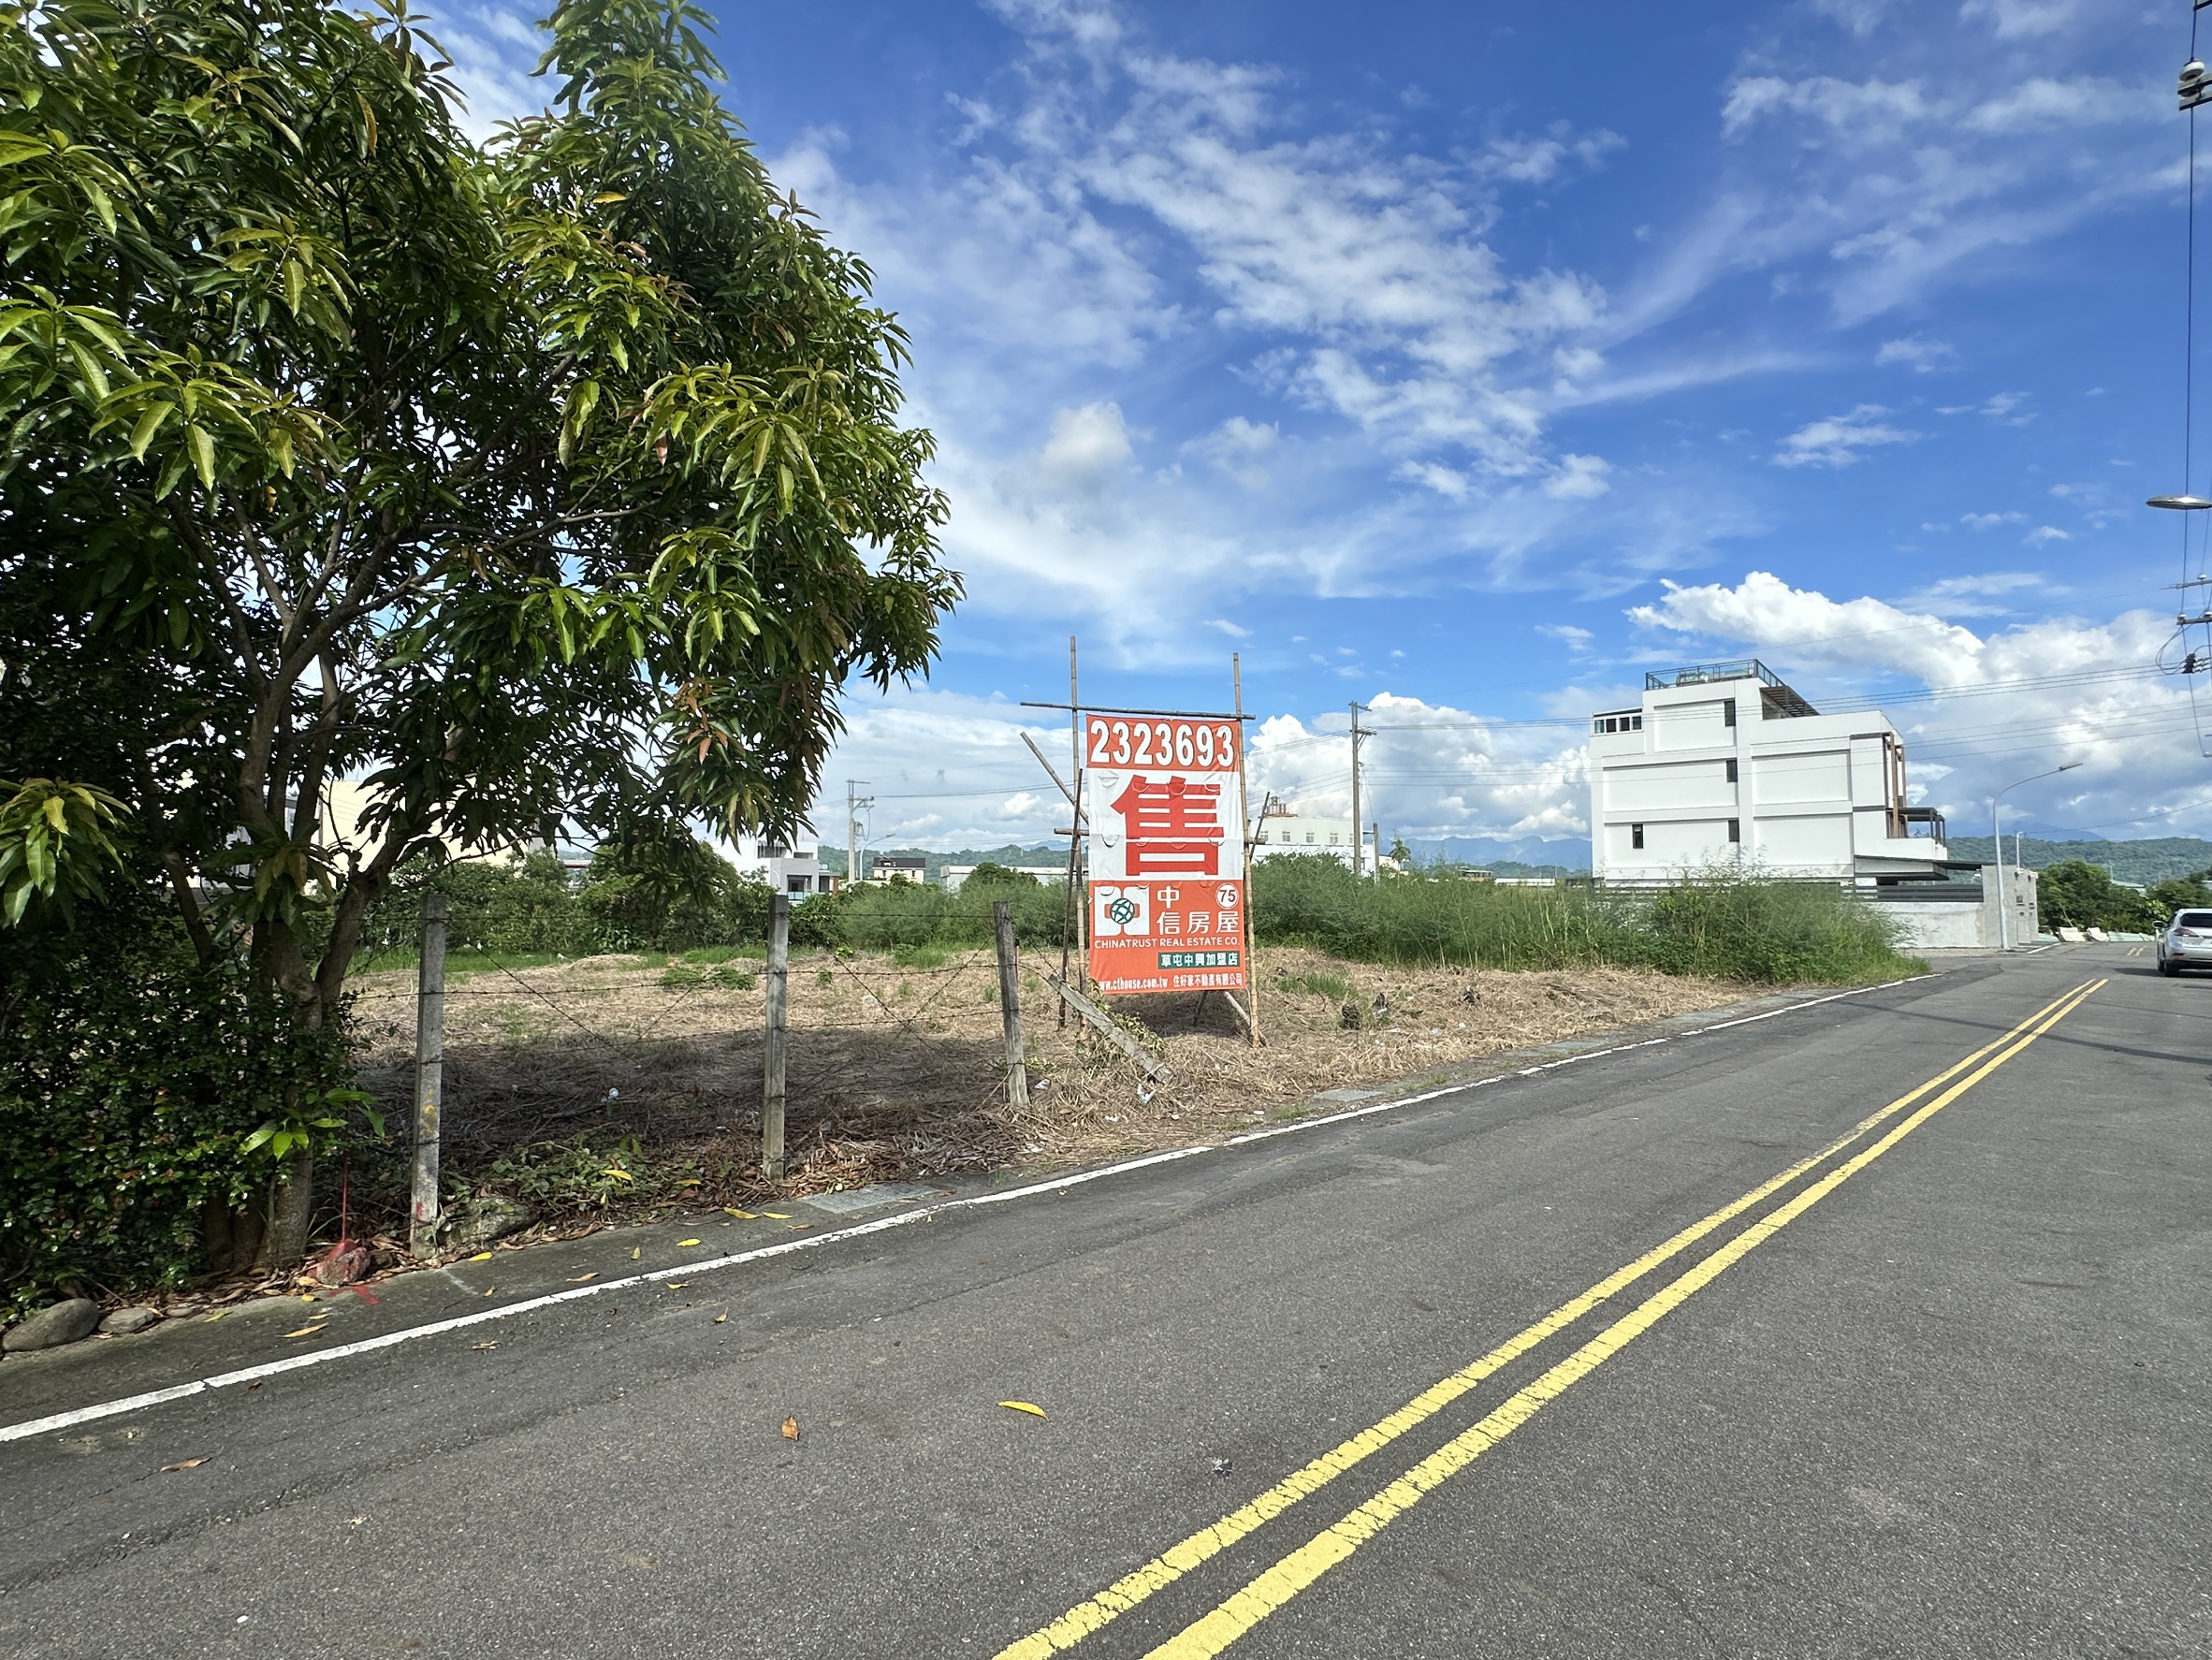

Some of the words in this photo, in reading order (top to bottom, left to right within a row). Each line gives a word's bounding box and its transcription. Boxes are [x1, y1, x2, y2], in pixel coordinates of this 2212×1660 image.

[1090, 720, 1234, 767] 2323693
[1111, 775, 1224, 876] 售
[1219, 889, 1236, 899] 75
[1095, 939, 1157, 949] CHINATRUST
[1160, 938, 1185, 948] REAL
[1187, 937, 1222, 946] ESTATE
[1225, 937, 1240, 945] CO.
[1161, 953, 1238, 967] 草屯中興加盟店
